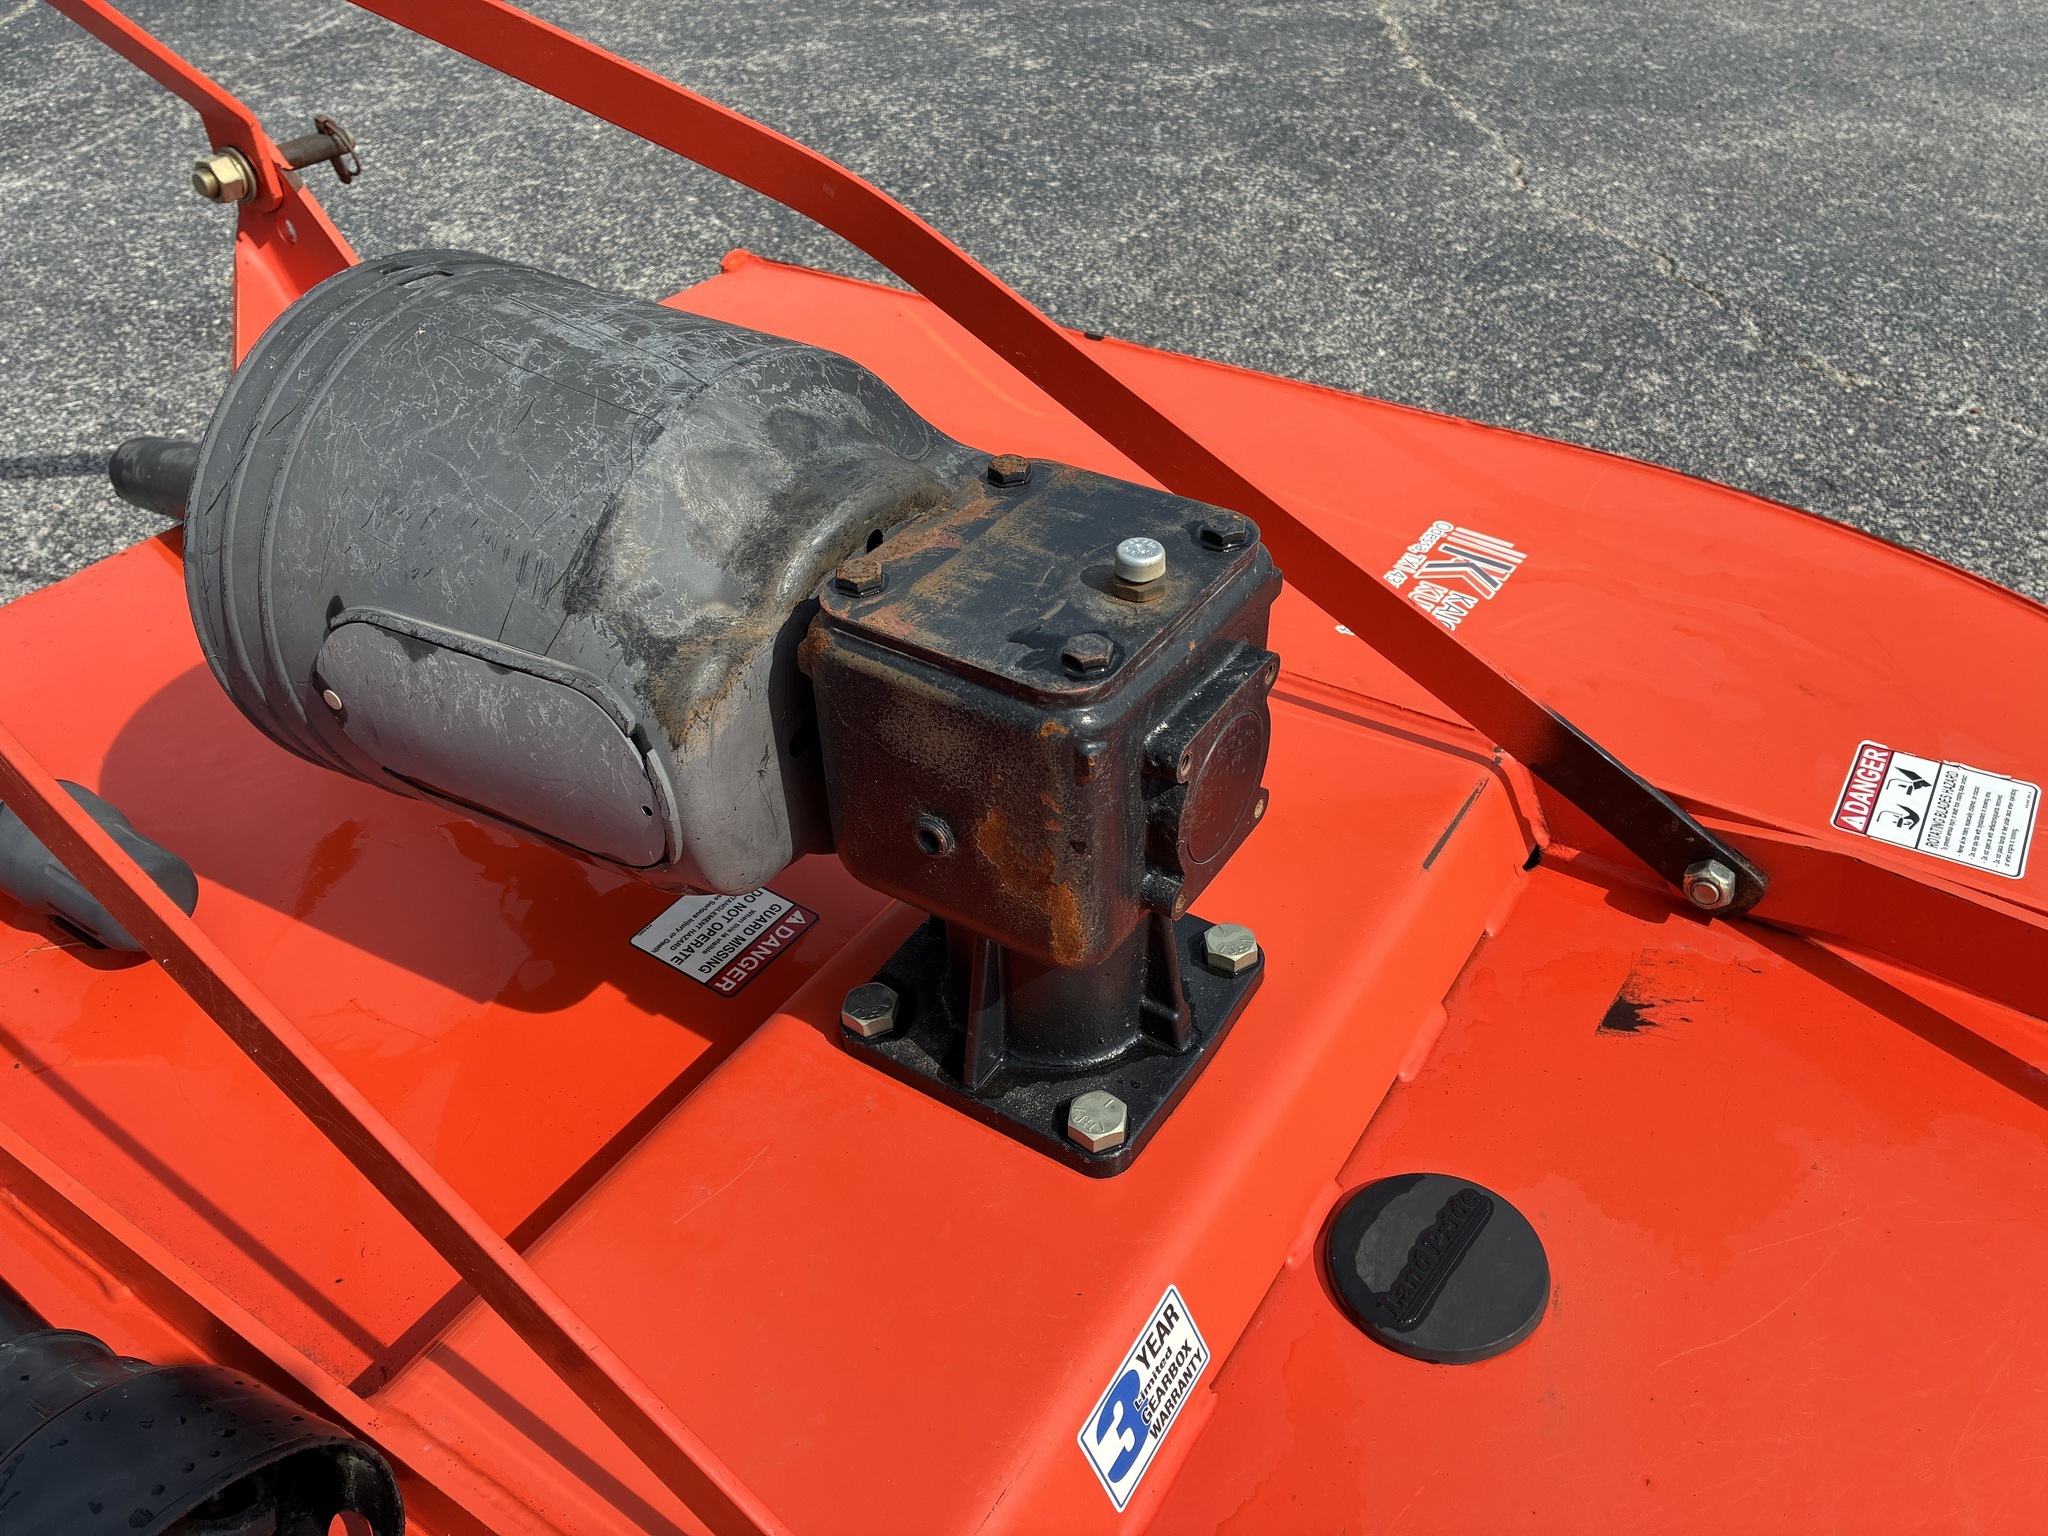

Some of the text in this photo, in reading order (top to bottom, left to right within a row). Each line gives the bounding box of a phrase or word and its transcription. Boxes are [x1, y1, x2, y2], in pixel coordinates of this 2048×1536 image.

[1843, 749, 1889, 816] DANGER
[1925, 771, 1959, 849] ROTATING BLADES HAZARD
[676, 918, 694, 934] Injury
[692, 900, 715, 920] Serious
[722, 902, 746, 923] NOT
[727, 921, 741, 934] this
[738, 909, 756, 926] When
[651, 936, 671, 953] Death
[670, 928, 697, 951] HAZARD
[670, 922, 723, 965] OPERATE
[698, 903, 782, 974] GUARD MISSING
[702, 935, 724, 954] visible
[715, 924, 795, 992] DANGER
[1135, 1303, 1180, 1370] YEAR
[1135, 1346, 1173, 1411] Limited
[1141, 1337, 1193, 1426] GEARBOX
[1149, 1347, 1203, 1441] WARRANTY
[1096, 1368, 1151, 1483] 3
